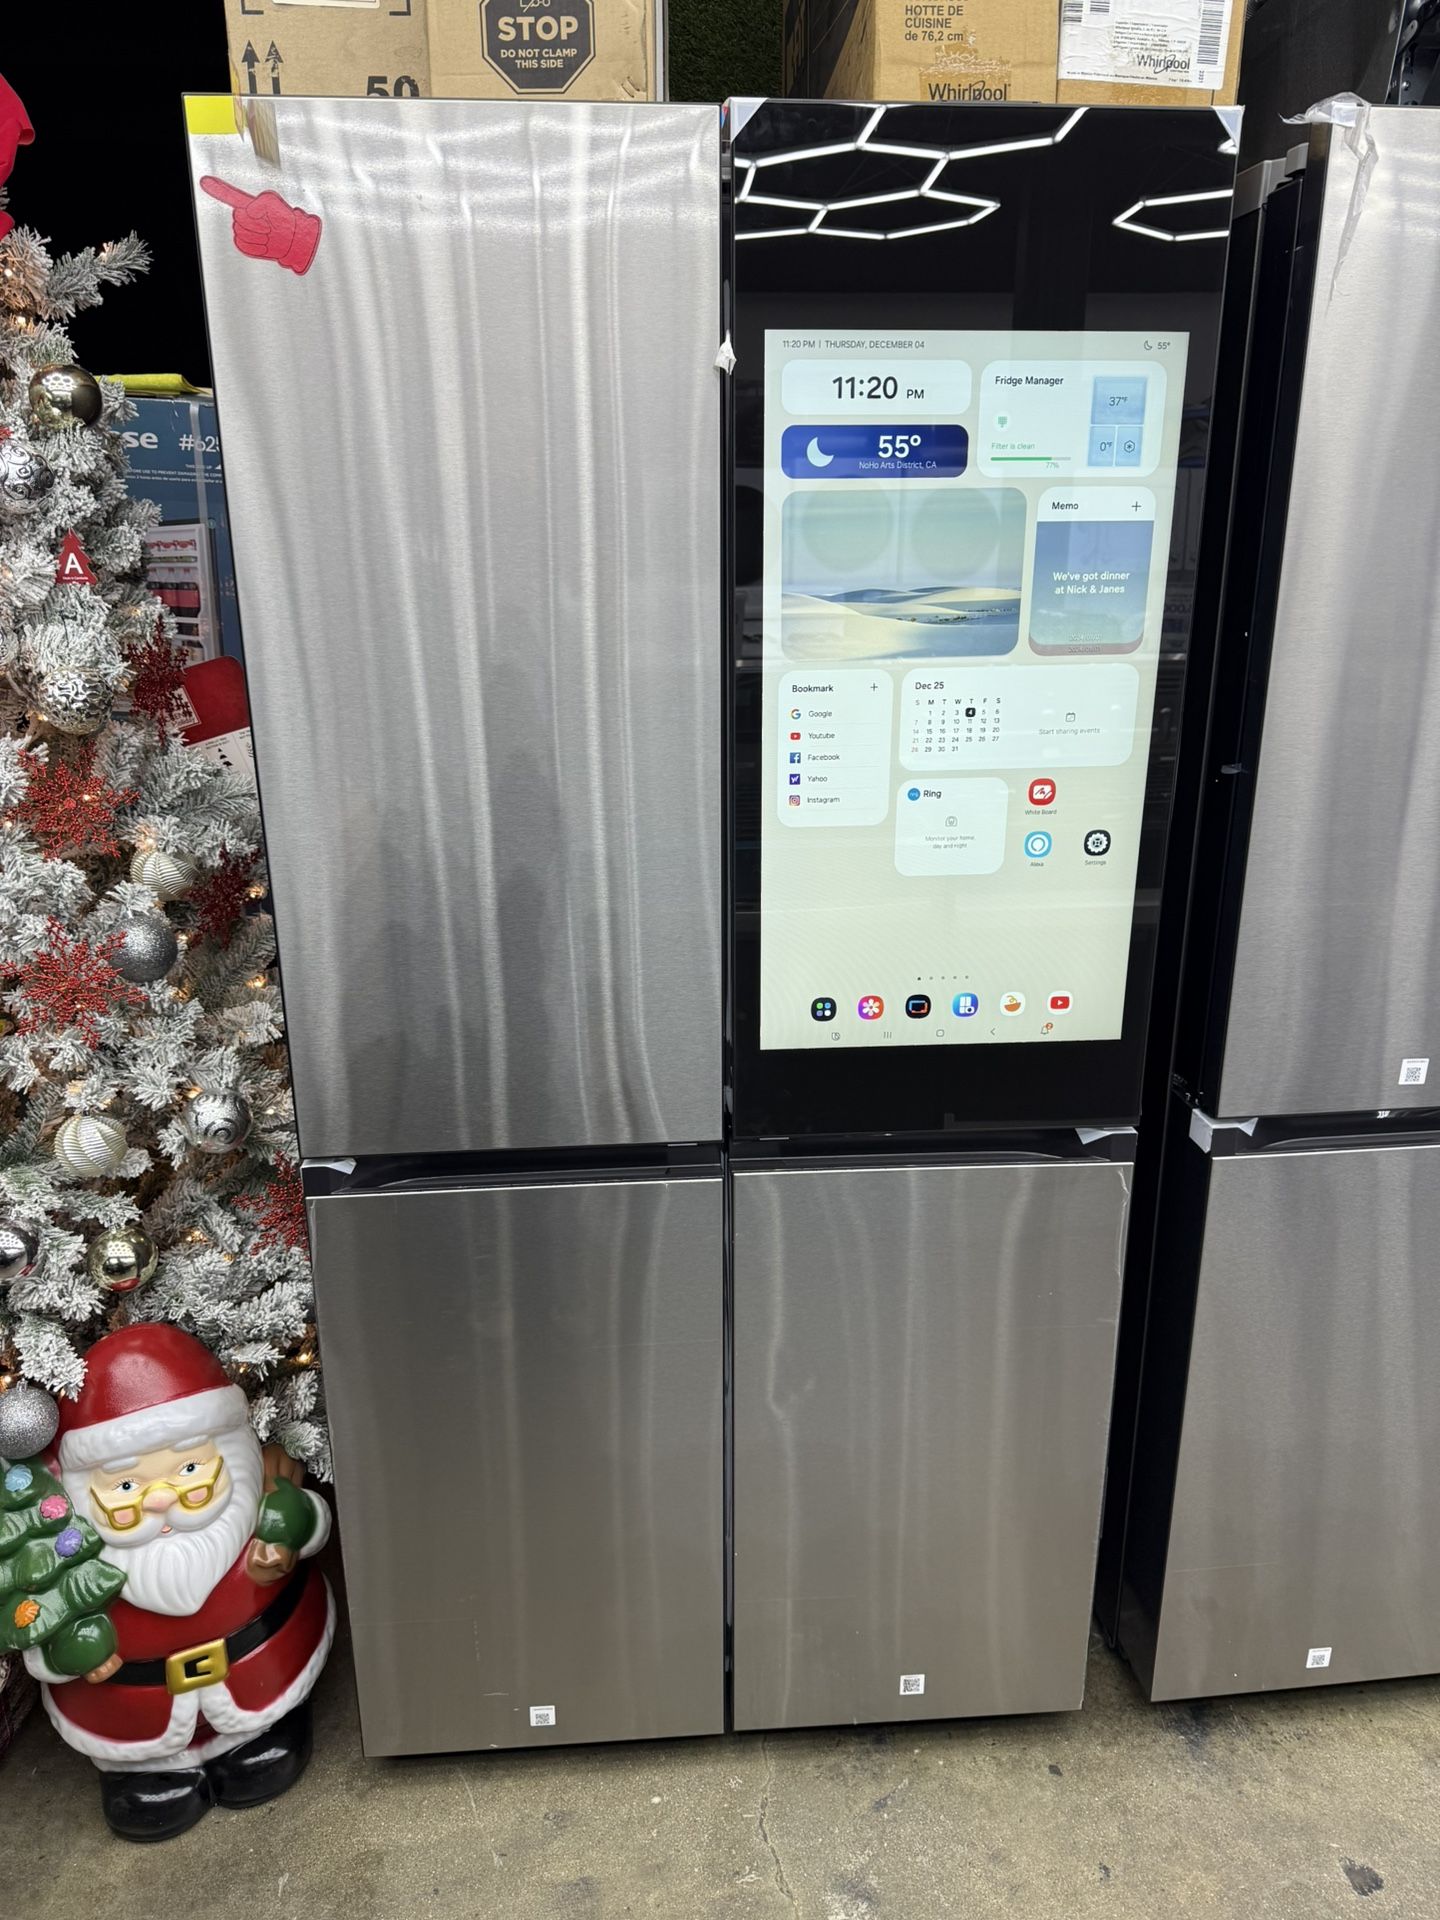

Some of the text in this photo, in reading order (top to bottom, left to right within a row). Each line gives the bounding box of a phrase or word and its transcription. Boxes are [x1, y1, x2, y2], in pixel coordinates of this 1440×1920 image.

[905, 5, 963, 16] HOTTE DE
[498, 15, 579, 41] STOP
[905, 18, 952, 28] CUISINE
[905, 31, 964, 43] de 76,2 cm
[500, 48, 577, 58] DO NOT CLAMP
[515, 59, 564, 68] THIS SIDE
[1137, 54, 1190, 74] Whirlpool
[928, 80, 1007, 101] Whirlpool
[782, 340, 925, 349] 11:20 PM THURSDAY, DECEMBER 04
[995, 376, 1064, 387] Fridge Manager
[832, 376, 925, 399] 11:20 PM
[878, 435, 921, 458] 55°
[859, 461, 879, 469] NoHo
[880, 461, 895, 469] Arts
[896, 461, 924, 469] District,
[1051, 502, 1079, 510] Memo
[65, 553, 83, 574] A
[1053, 571, 1130, 582] We've got dinner
[1067, 585, 1087, 594] Nick
[1090, 584, 1096, 593] &
[1099, 585, 1125, 593] Janes
[792, 685, 834, 693] Bookmark
[915, 682, 932, 690] Dec
[808, 710, 832, 718] Google
[923, 790, 942, 799] Ring
